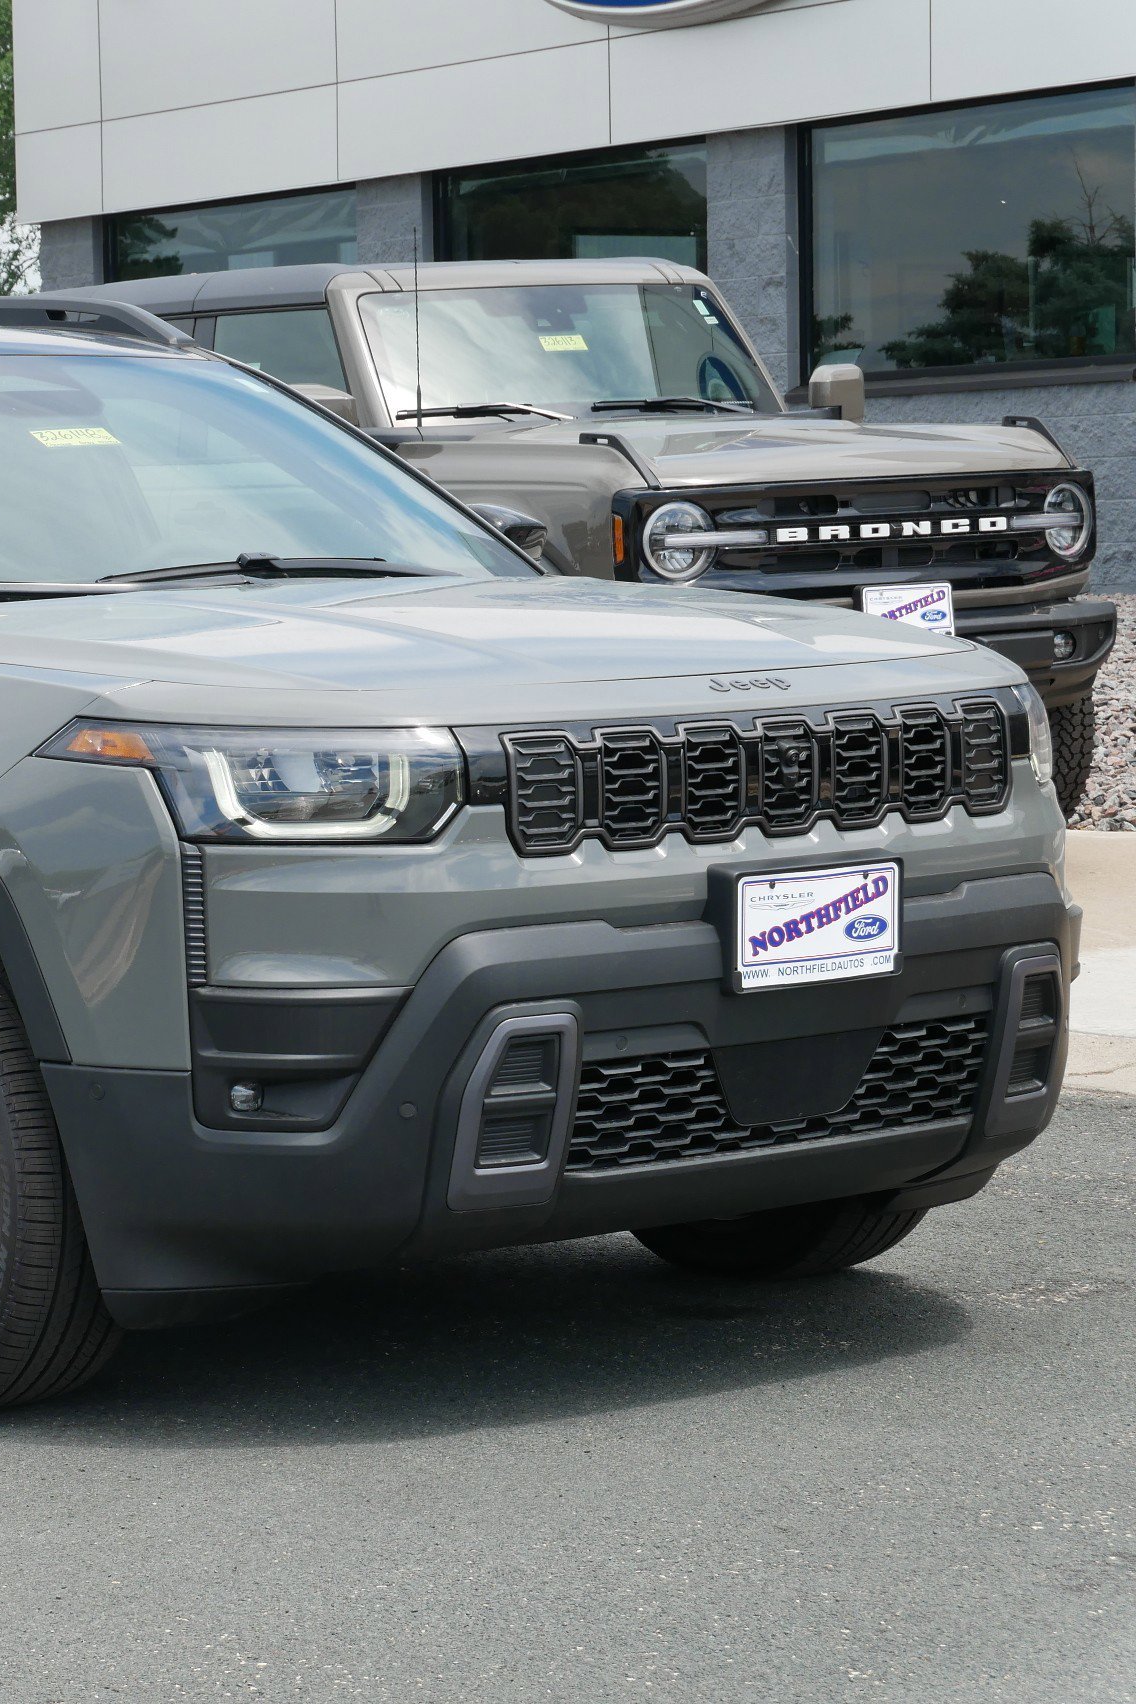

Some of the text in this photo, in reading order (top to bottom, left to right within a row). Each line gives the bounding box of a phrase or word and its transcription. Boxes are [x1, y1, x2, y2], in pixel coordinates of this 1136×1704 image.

[776, 516, 1008, 543] BRONCO
[708, 677, 792, 693] Jeep
[750, 892, 814, 903] CHRYSLER
[748, 875, 889, 957] NORTHFIELD
[851, 917, 880, 938] Ford
[777, 958, 865, 977] NORTHFIELDAUTOS
